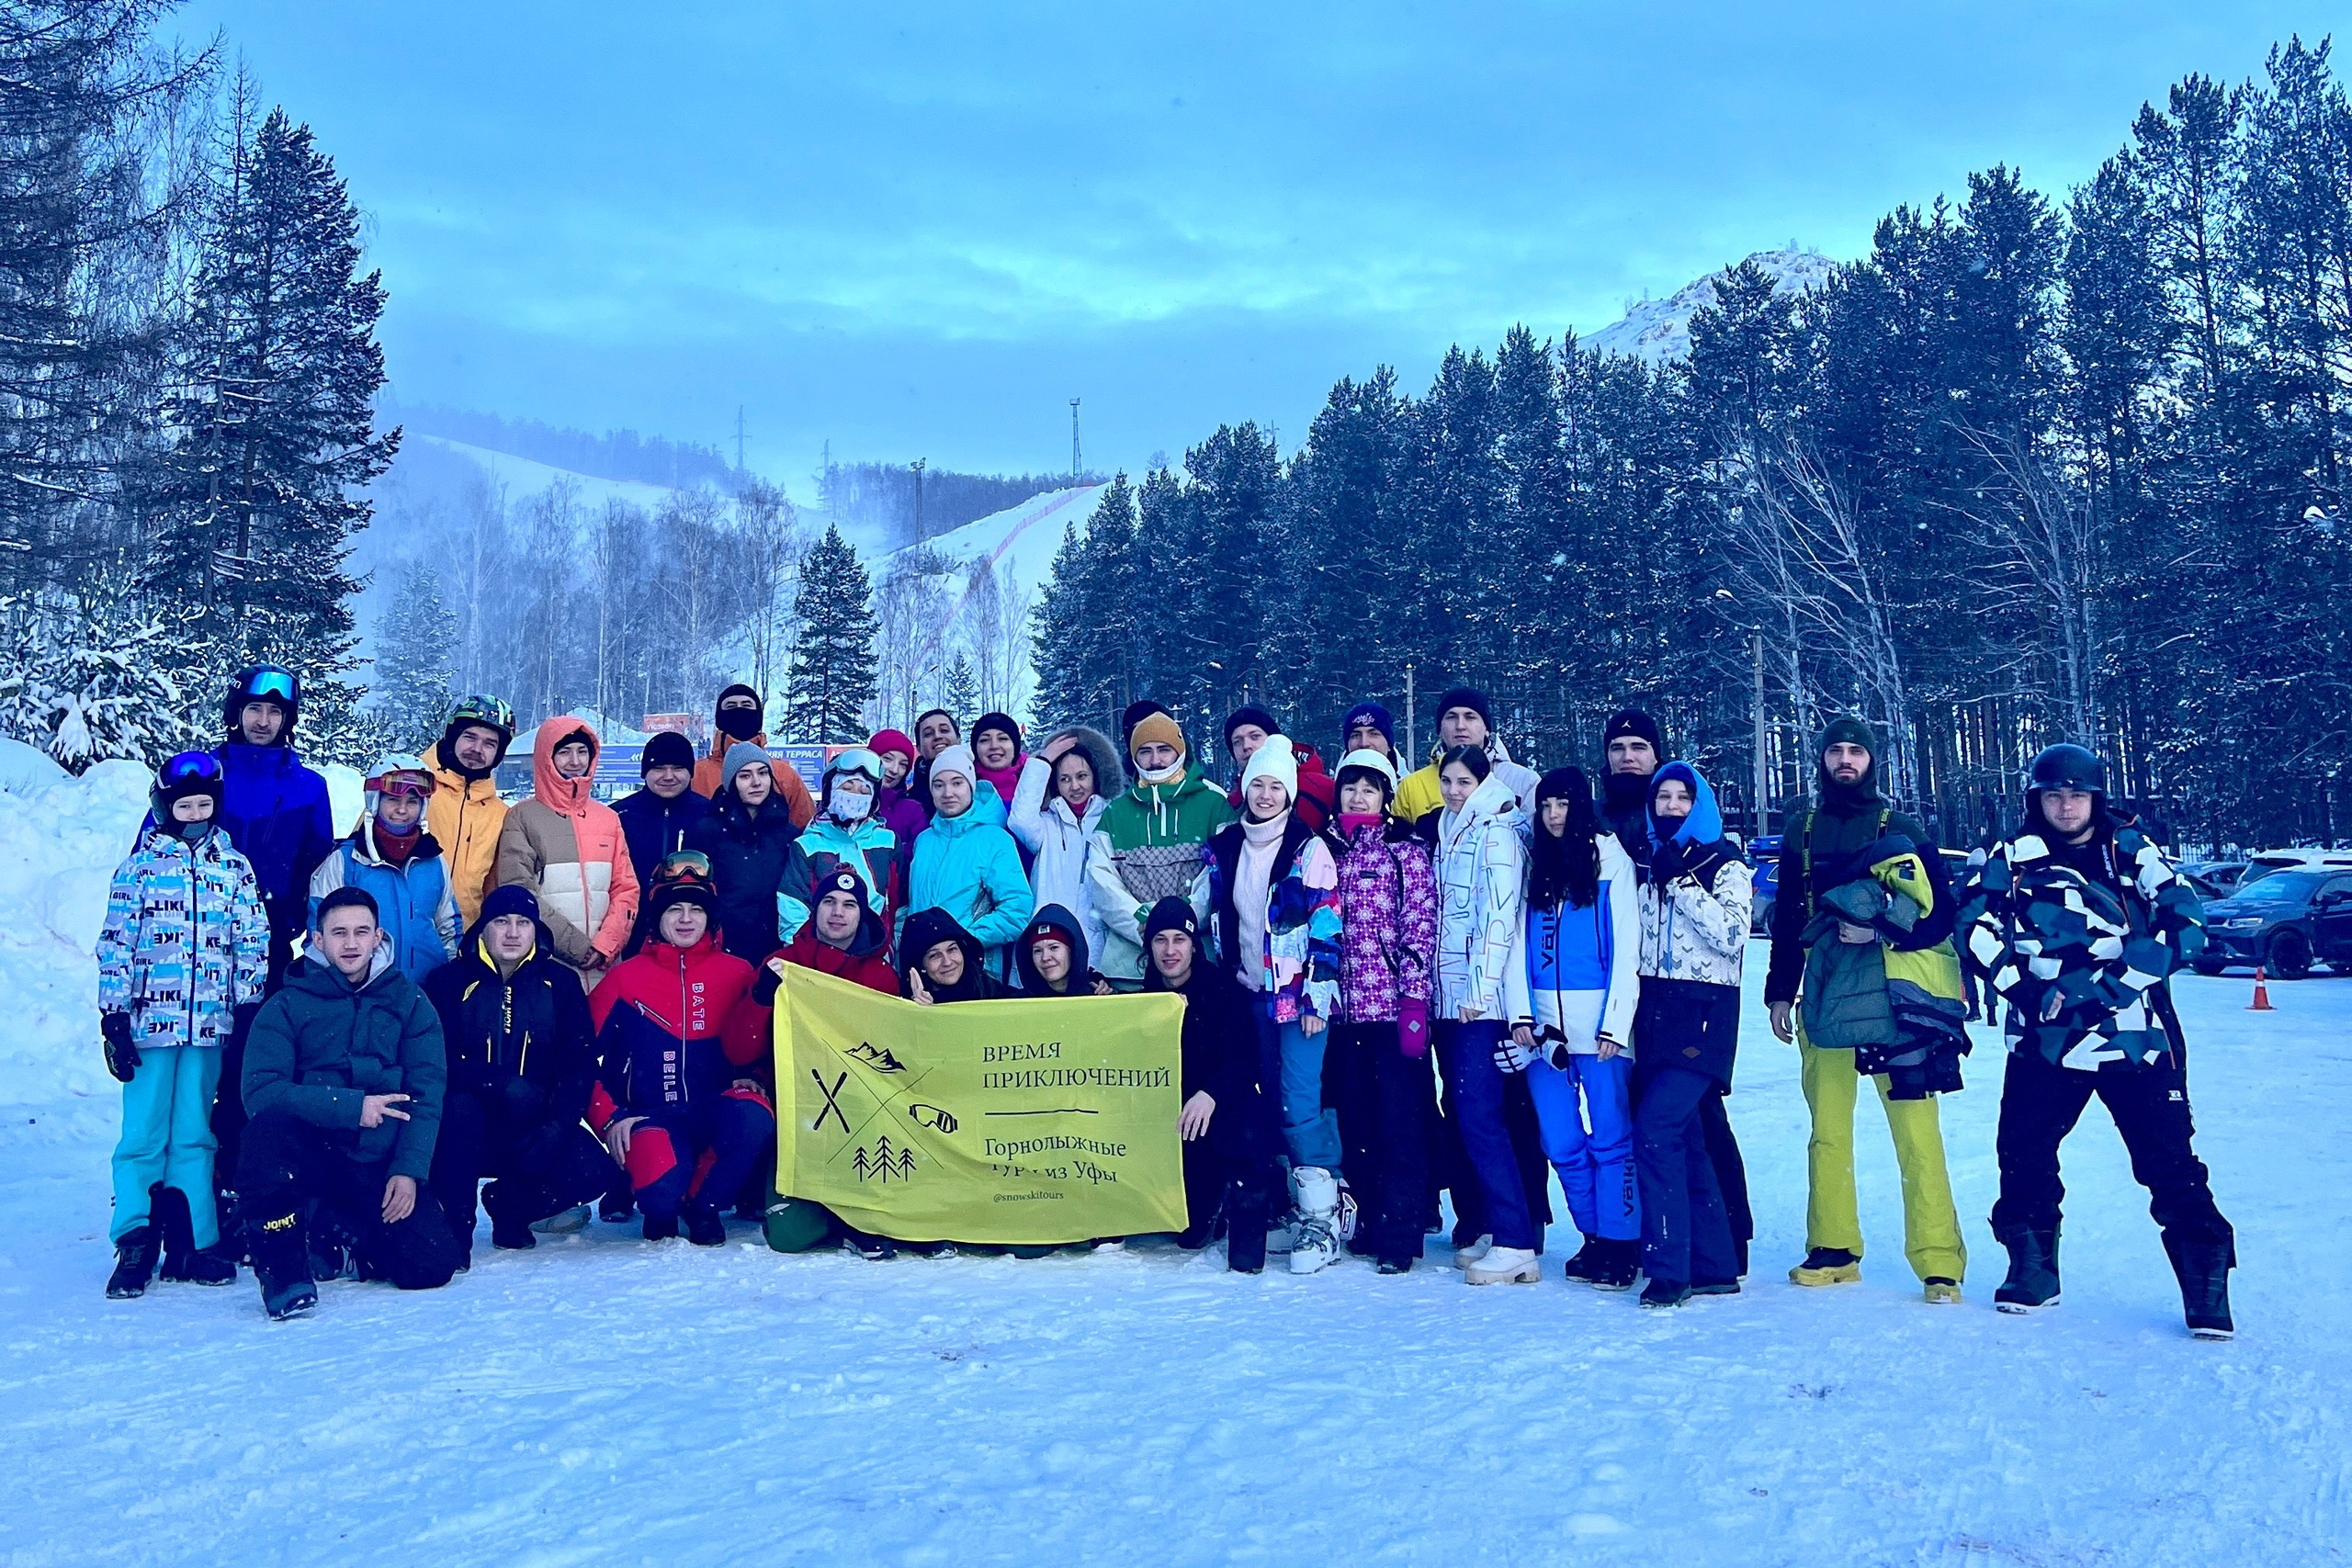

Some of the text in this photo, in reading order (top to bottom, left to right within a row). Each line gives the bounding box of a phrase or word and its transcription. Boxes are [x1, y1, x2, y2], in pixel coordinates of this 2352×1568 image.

[785, 750, 823, 760] ТЕРРАСА
[692, 982, 706, 1032] BATE
[982, 1042, 1062, 1063] ВРЕМЯ
[662, 1050, 678, 1102] BEILE
[982, 1066, 1170, 1089] ПРИКЛЮЧЕНИЙ
[984, 1135, 1127, 1161] Горнолыжные
[1045, 1167, 1068, 1179] из
[1072, 1160, 1117, 1186] Уфы
[993, 1190, 1065, 1203] @snowskitours
[263, 1213, 296, 1231] JOINT
